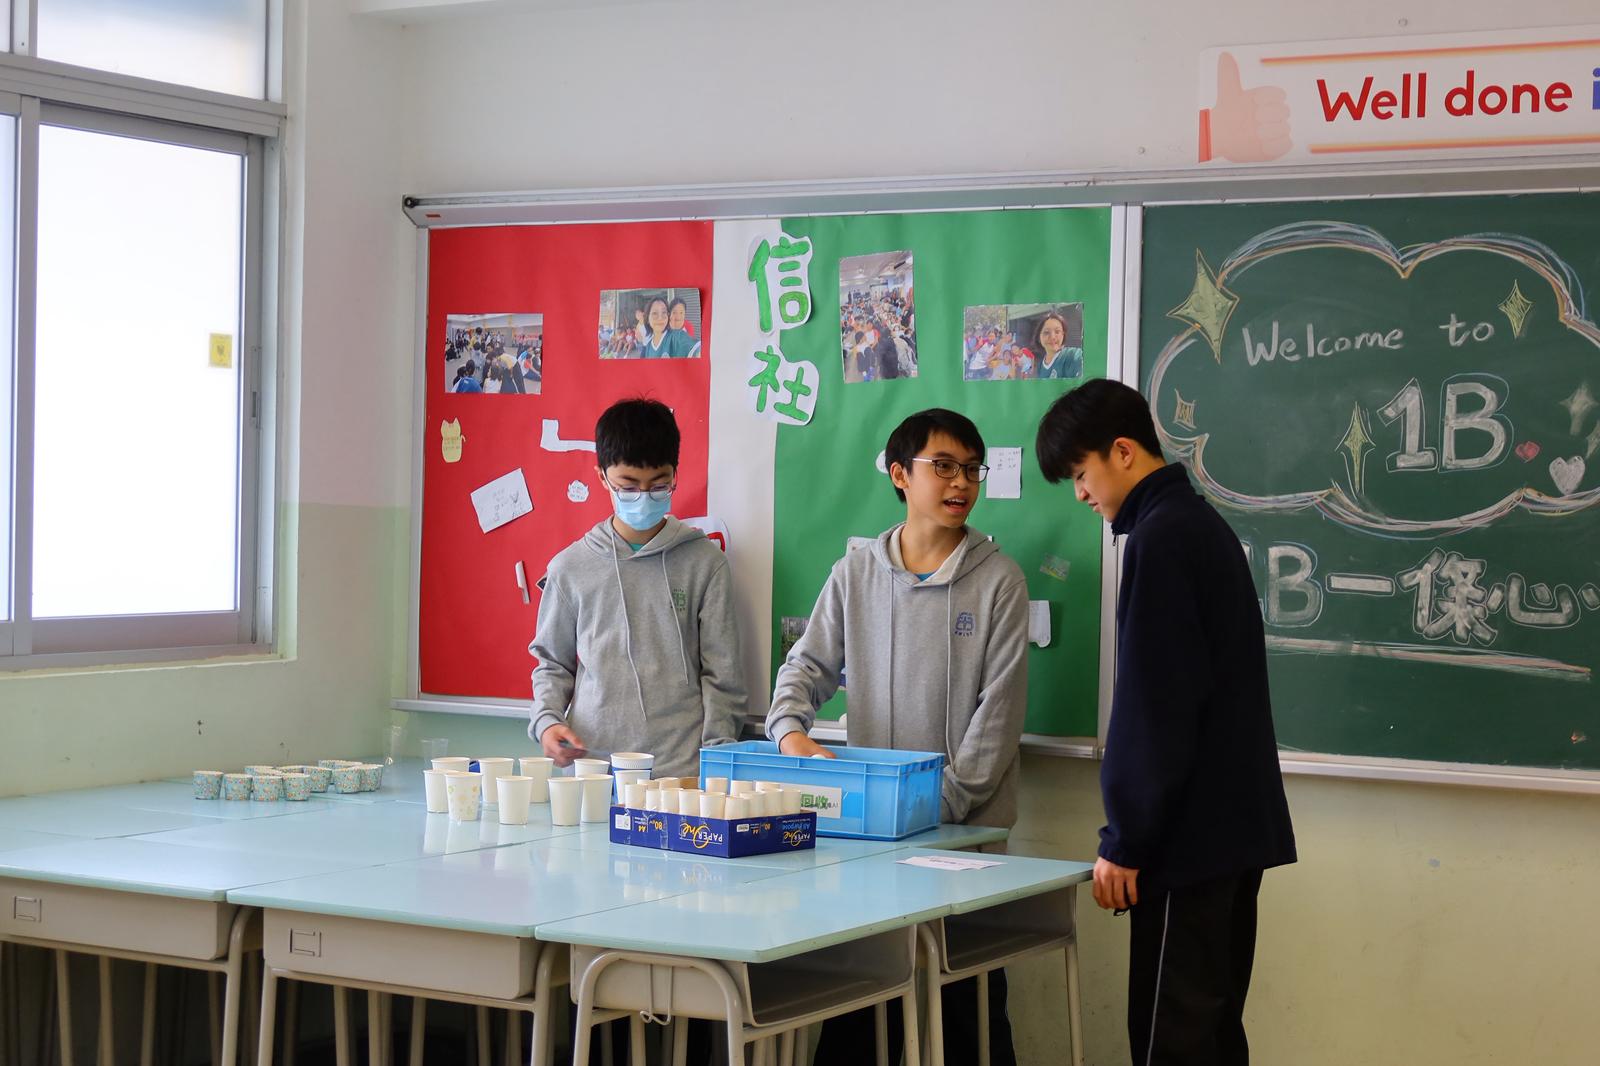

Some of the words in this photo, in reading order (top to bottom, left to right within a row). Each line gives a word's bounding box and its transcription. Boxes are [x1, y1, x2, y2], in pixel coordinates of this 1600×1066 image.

[1316, 72, 1427, 122] Well
[1444, 70, 1573, 116] done
[748, 236, 812, 423] 信社
[1242, 320, 1405, 366] Welcome
[1439, 313, 1495, 347] to
[1378, 376, 1511, 472] 1B
